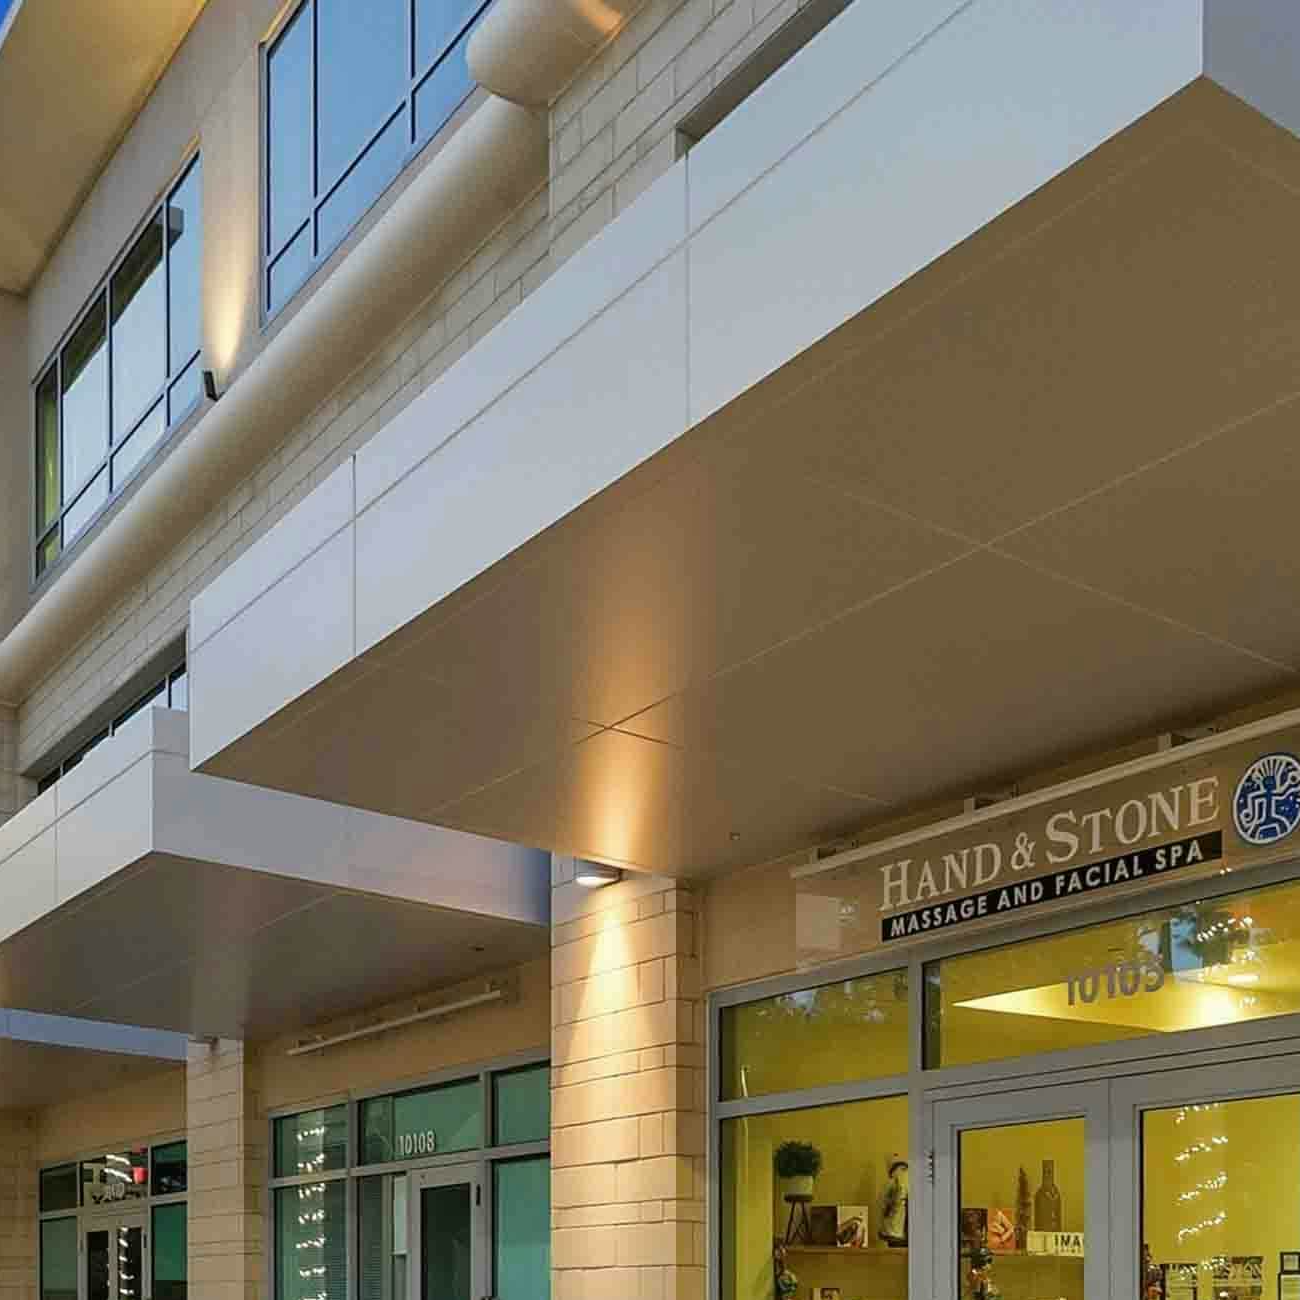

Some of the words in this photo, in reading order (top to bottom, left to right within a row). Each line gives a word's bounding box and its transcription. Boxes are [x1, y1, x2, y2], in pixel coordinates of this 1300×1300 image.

[878, 843, 1002, 912] HAND
[1010, 832, 1037, 871] &
[1045, 776, 1220, 865] STONE
[891, 896, 988, 937] MASSAGE
[997, 881, 1044, 911] AND
[1055, 855, 1143, 896] FACIAL
[1155, 840, 1203, 870] SPA
[398, 1131, 435, 1154] 10108
[1053, 1233, 1084, 1250] IMA
